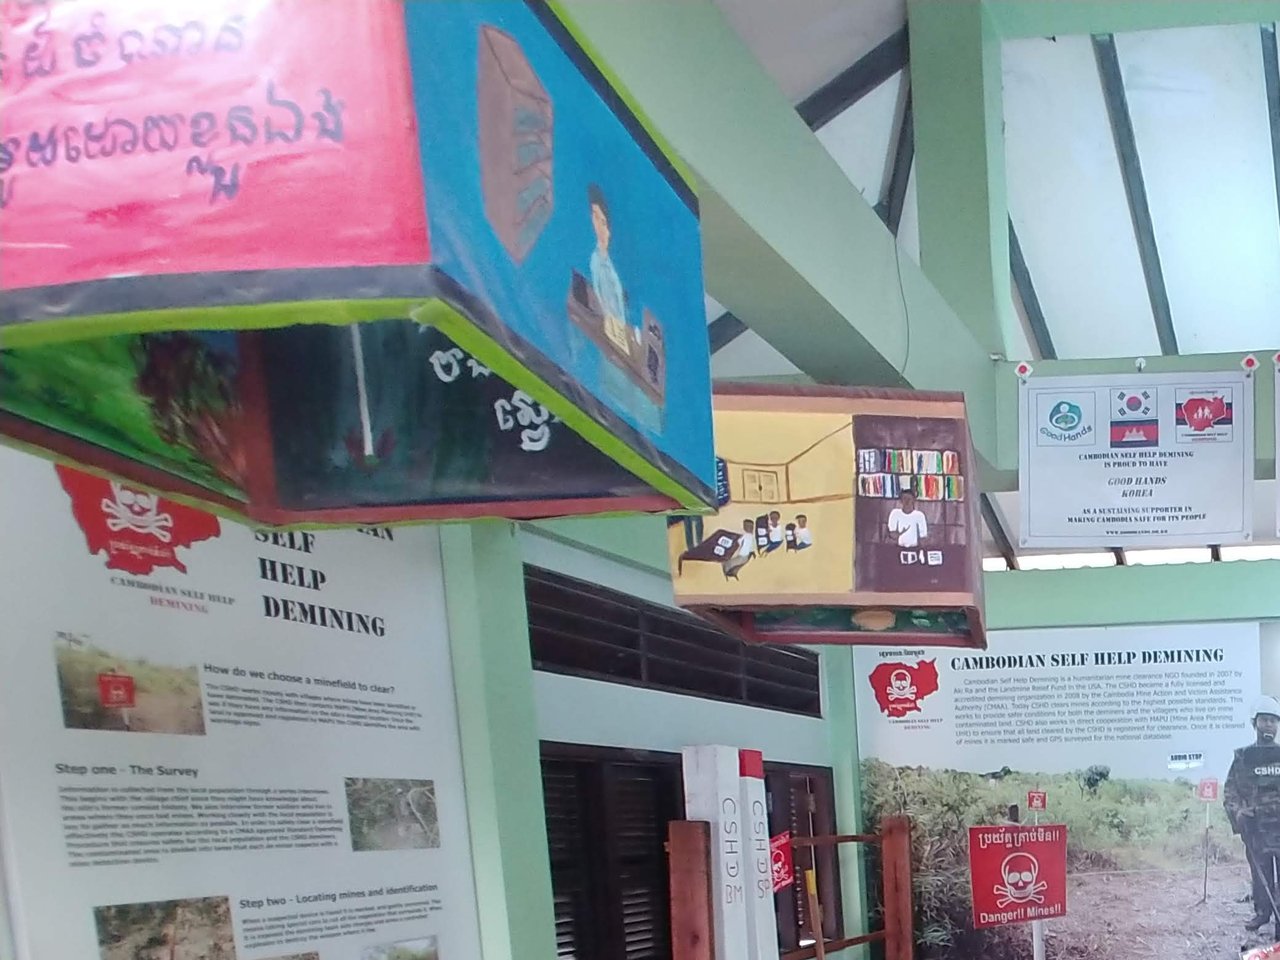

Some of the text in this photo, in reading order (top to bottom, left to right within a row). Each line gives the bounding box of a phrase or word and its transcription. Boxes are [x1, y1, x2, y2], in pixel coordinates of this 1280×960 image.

[1078, 452, 1119, 461] CAMBODIAN
[1108, 476, 1167, 486] GOOD HANDS
[1121, 489, 1153, 498] KOREA
[1096, 515, 1132, 523] CAMBODIA
[1142, 506, 1183, 514] SUPPORTER
[254, 529, 316, 554] SELF
[258, 557, 326, 591] HELP
[110, 576, 236, 606] CAMBODIAN SELF HELP
[149, 596, 208, 614] DEMINING
[262, 595, 386, 637] DEMINING
[951, 648, 1224, 671] CAMBODIAN SELF HELP DEMINING
[203, 663, 230, 675] How
[233, 667, 246, 677] do
[249, 671, 265, 680] we
[267, 672, 303, 684] choose
[314, 678, 357, 691] minefield
[358, 683, 368, 692] to
[55, 763, 88, 776] Step
[91, 765, 116, 775] one
[129, 765, 153, 776] The
[157, 765, 199, 778] Survey
[1254, 767, 1280, 775] CSHD
[722, 798, 739, 878] CSHD
[752, 800, 768, 874] CSHD
[239, 899, 264, 909] Step
[266, 897, 287, 907] two
[296, 892, 337, 904] Locating
[339, 890, 366, 900] mines
[368, 888, 383, 897] and
[386, 883, 438, 895] identification
[980, 904, 1061, 923] Danger!! Mines!!
